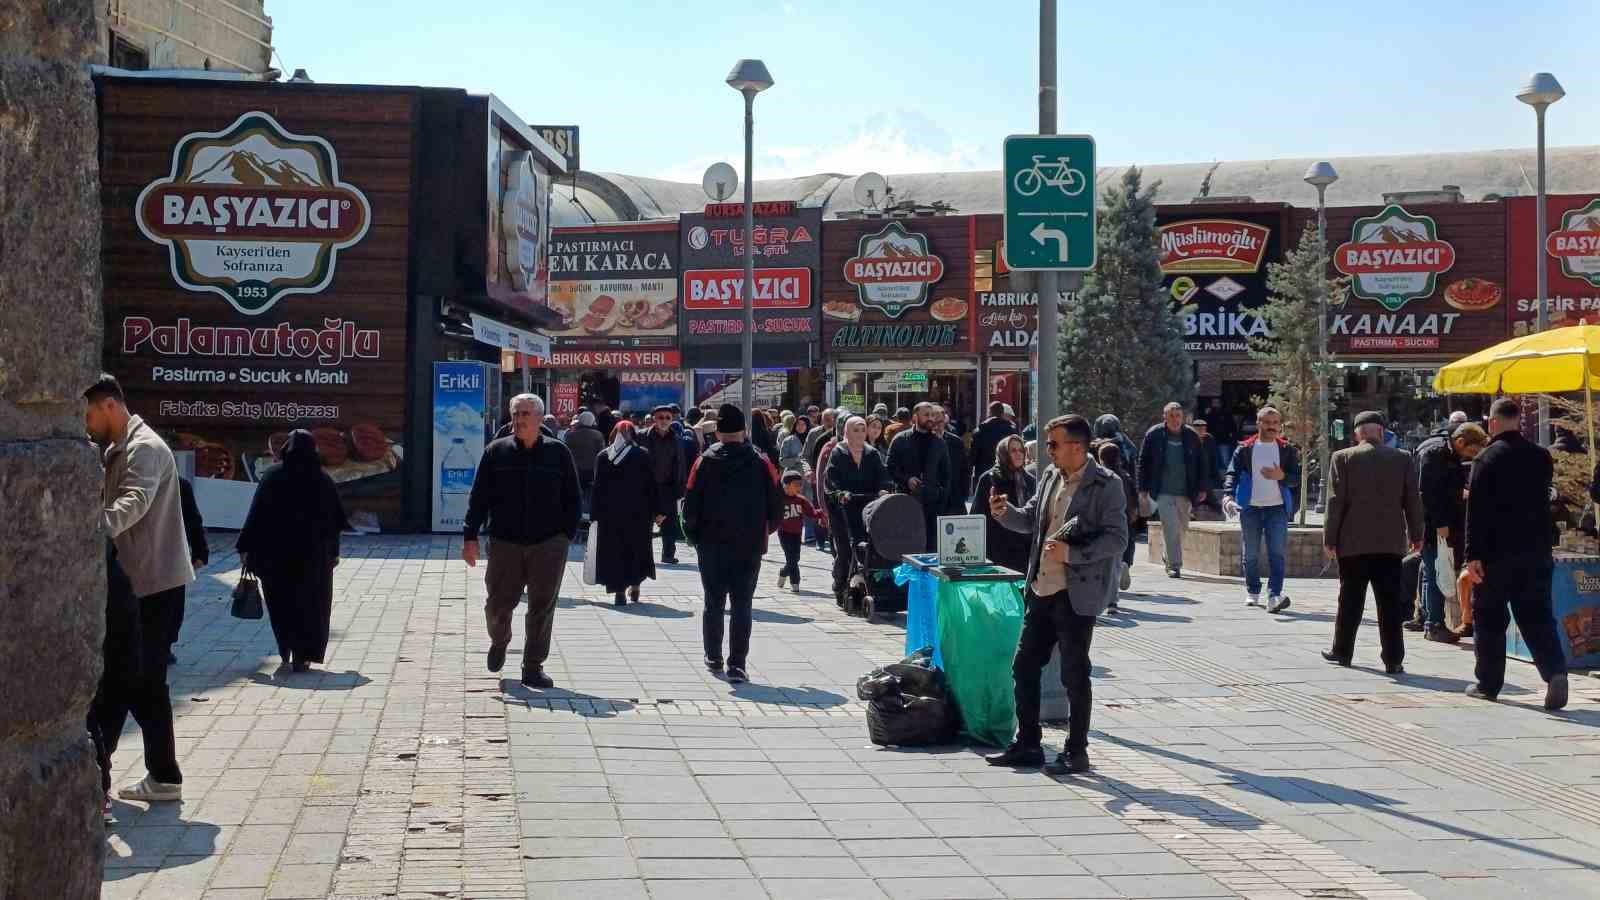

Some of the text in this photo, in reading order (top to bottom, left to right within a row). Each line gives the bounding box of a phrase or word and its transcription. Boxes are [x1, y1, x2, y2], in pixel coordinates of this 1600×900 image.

[163, 195, 339, 233] BAŞYAZICI
[557, 240, 634, 253] PASTIRMACI
[1161, 226, 1257, 257] Müslümoğlu
[215, 245, 291, 259] Kayseri'den
[585, 251, 672, 272] KARACA
[1347, 248, 1440, 268] BAŞYAZICI
[223, 259, 283, 272] Sofranıza
[854, 261, 931, 280] BAŞYAZICI
[236, 286, 268, 298] 1953
[690, 277, 800, 305] BAŞYAZICI
[1330, 314, 1460, 334] KANAAT
[122, 317, 381, 366] Palamutoğlu
[832, 325, 956, 347] ALTINOLUK
[152, 366, 349, 385] Pastırma Sucuk Mantı
[440, 374, 480, 389] Erikli
[159, 401, 339, 420] Fabrika Satış Mağazası
